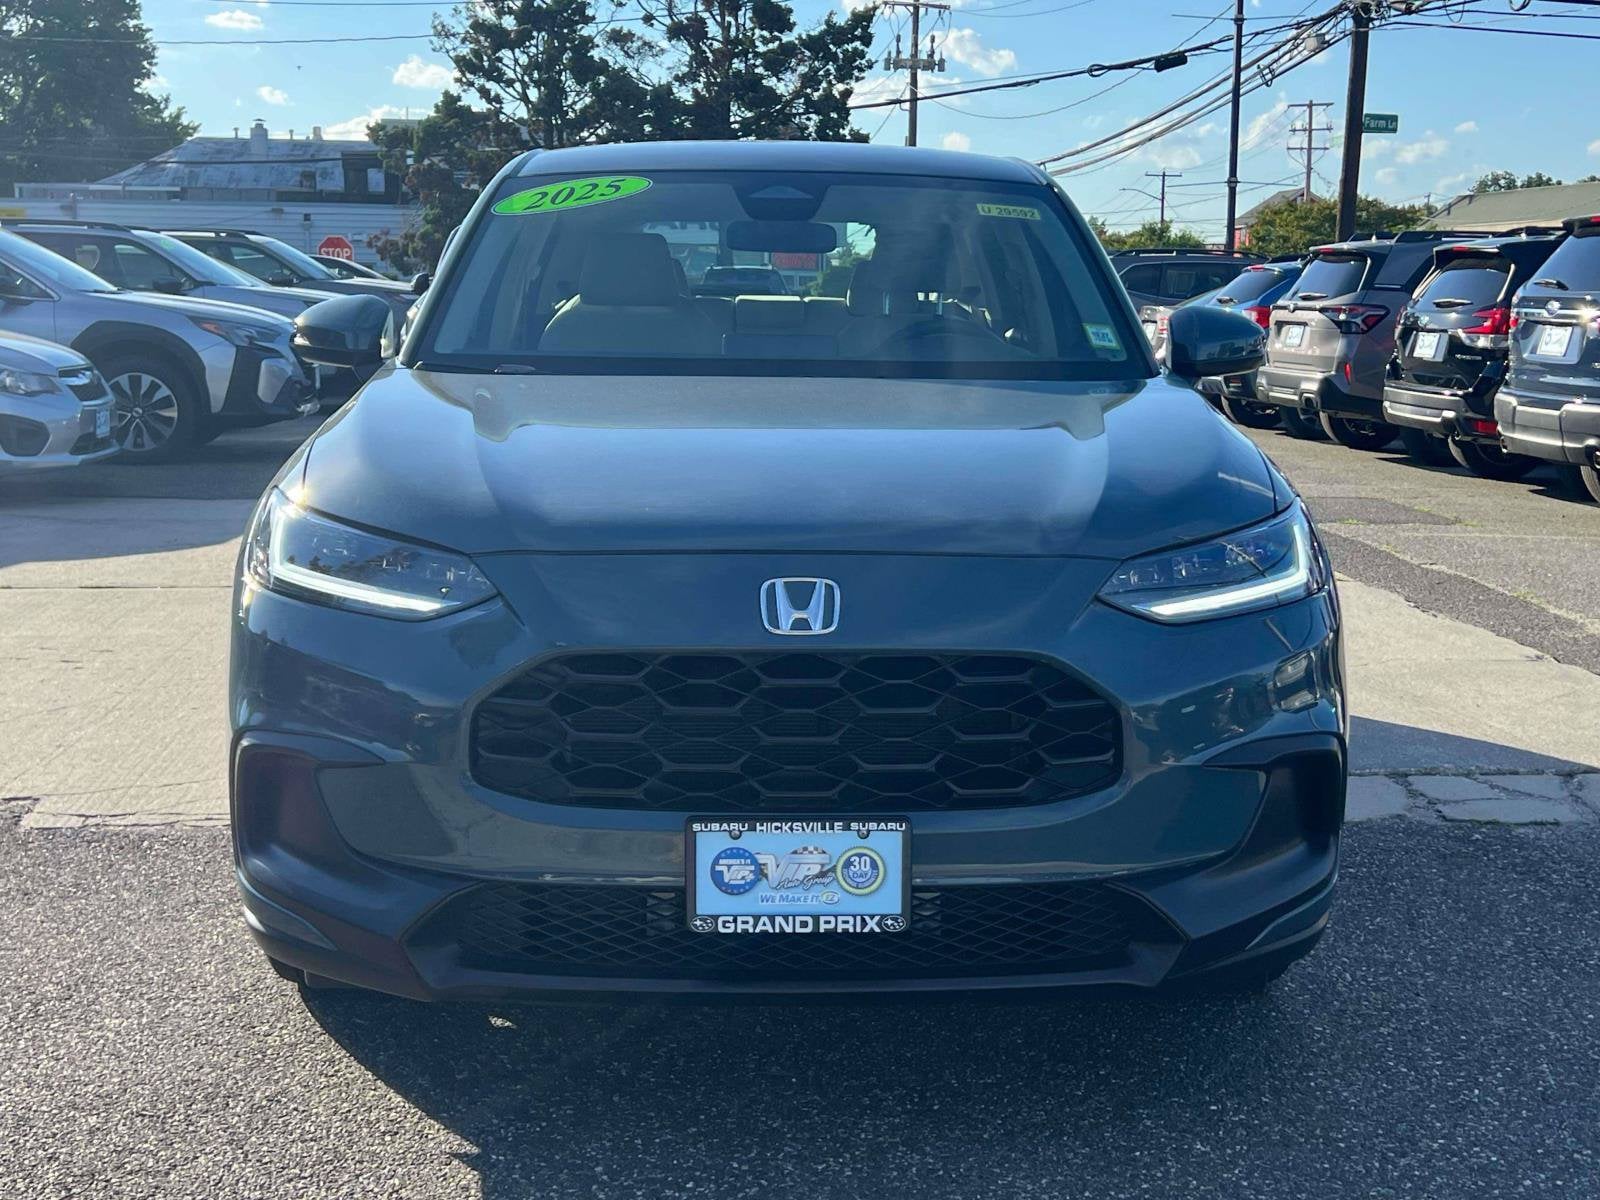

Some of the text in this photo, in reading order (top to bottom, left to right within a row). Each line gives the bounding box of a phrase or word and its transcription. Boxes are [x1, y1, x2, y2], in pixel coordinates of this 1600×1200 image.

[1364, 117, 1397, 129] Farm Ln
[523, 179, 625, 210] 2025
[321, 248, 350, 258] STOP
[692, 822, 906, 834] SUBARU HICKSVILLE SUBARU
[754, 853, 831, 889] VIP
[850, 855, 871, 871] 30
[776, 878, 801, 890] Auto
[802, 871, 834, 890] Group
[760, 894, 777, 904] WE
[778, 894, 809, 904] MAKE
[717, 915, 882, 933] GRAND PRIX
